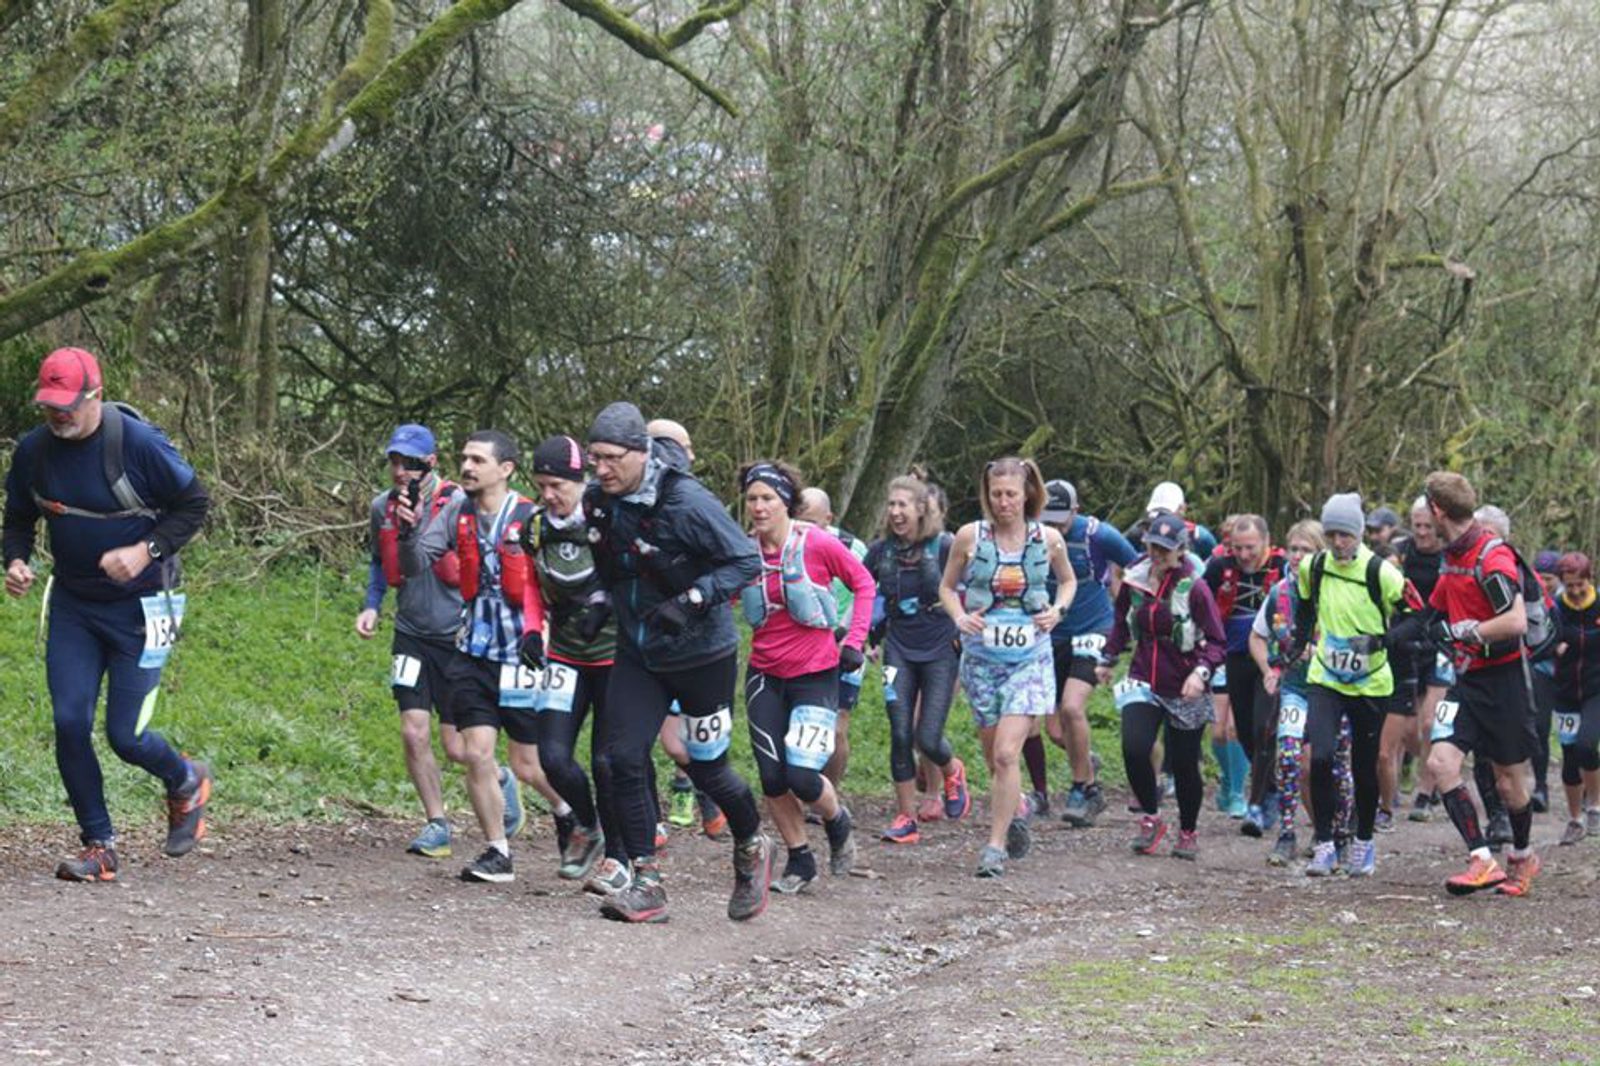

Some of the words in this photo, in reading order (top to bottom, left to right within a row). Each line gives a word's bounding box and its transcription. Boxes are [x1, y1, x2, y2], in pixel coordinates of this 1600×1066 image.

[994, 625, 1027, 647] 166
[1331, 647, 1362, 672] 176
[685, 715, 722, 743] 169
